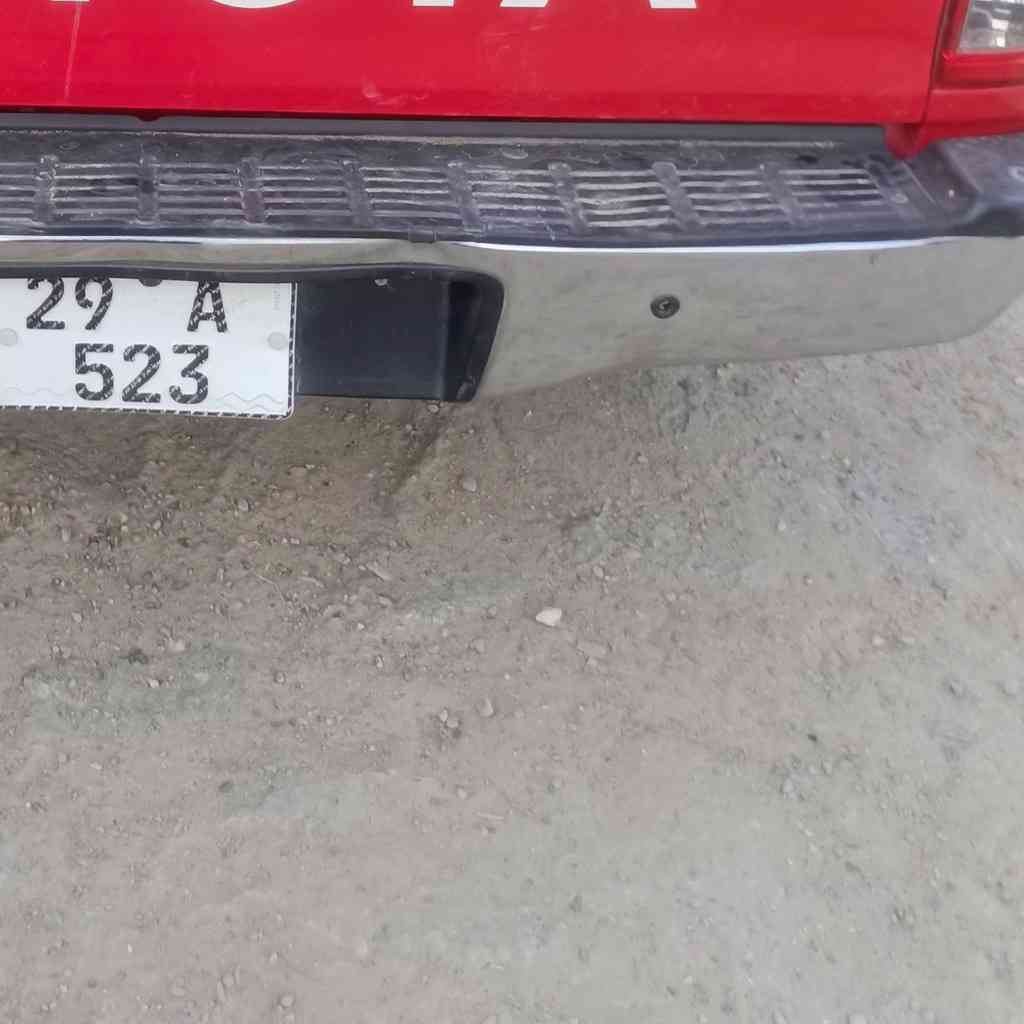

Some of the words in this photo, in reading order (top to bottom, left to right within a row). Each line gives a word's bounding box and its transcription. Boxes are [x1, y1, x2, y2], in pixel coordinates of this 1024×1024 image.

[26, 277, 114, 331] 29
[187, 281, 228, 333] A
[74, 343, 210, 404] 523
